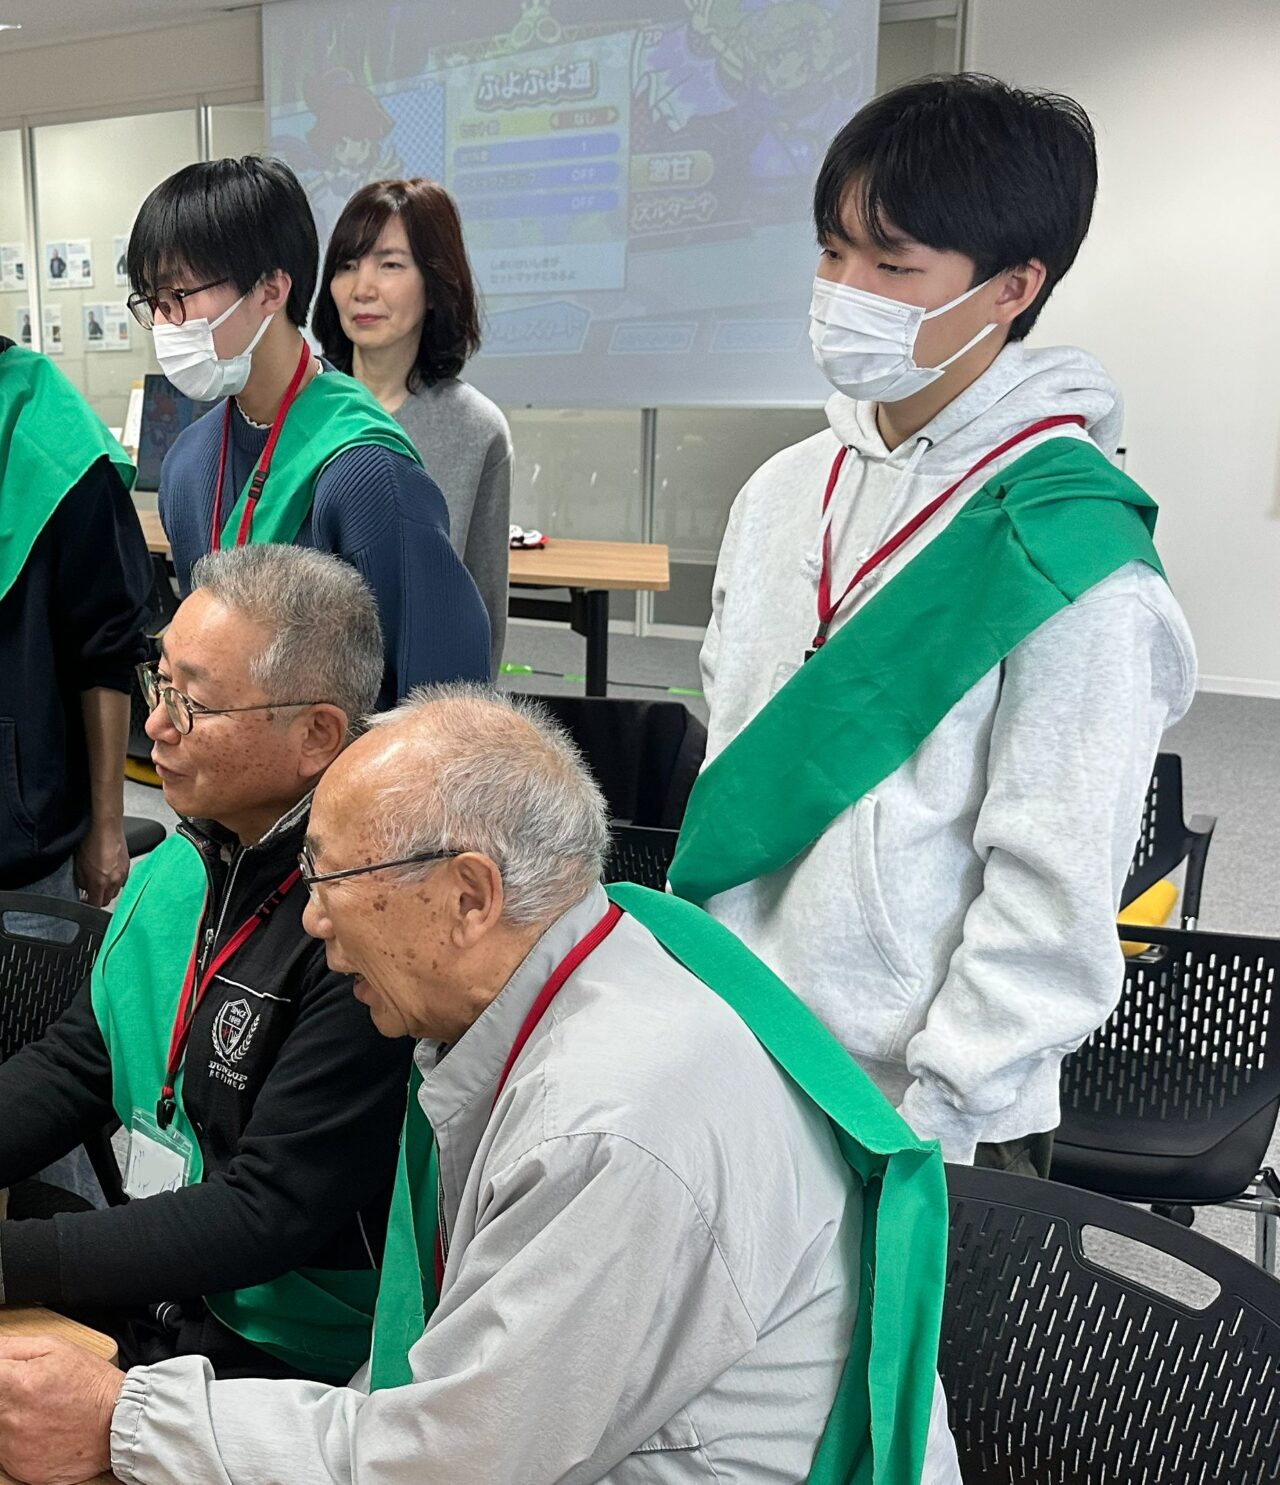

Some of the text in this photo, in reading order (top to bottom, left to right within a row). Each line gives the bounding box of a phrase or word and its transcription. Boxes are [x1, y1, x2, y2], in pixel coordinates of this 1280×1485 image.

[230, 1006, 247, 1018] SINCE
[208, 1061, 247, 1082] DUNLOP
[209, 1071, 245, 1090] REFINED
